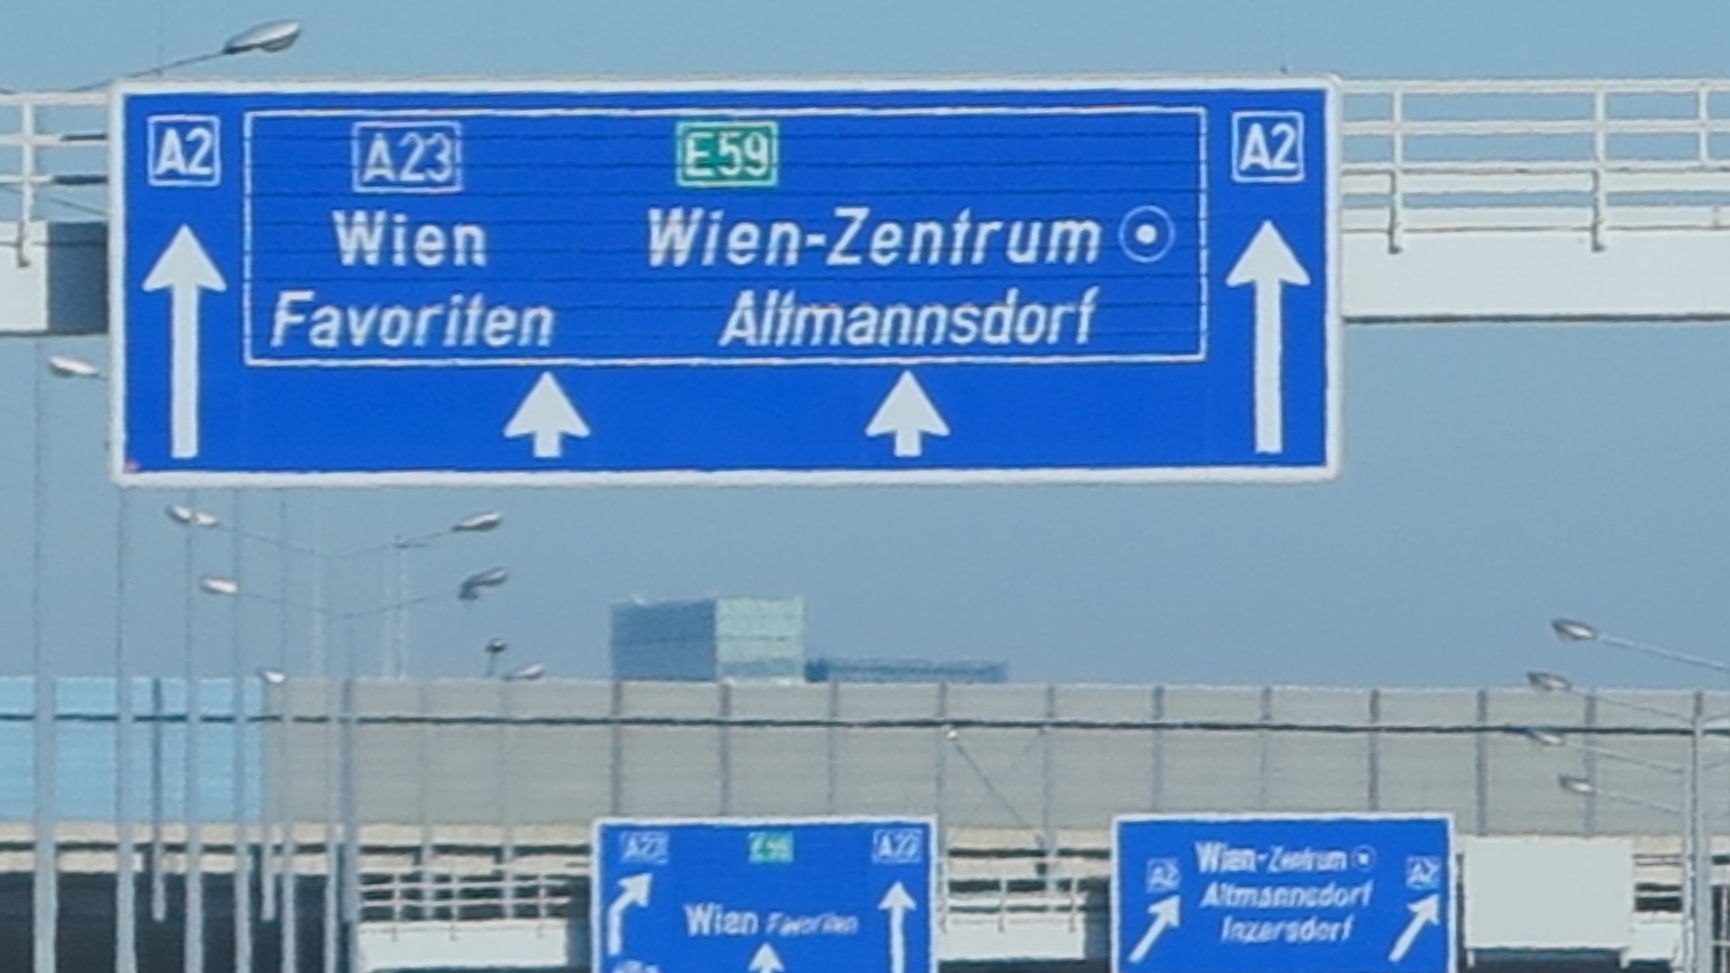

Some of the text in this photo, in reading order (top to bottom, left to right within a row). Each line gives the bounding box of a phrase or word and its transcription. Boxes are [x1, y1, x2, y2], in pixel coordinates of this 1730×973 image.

[155, 128, 214, 176] A2
[363, 135, 452, 181] A23
[684, 133, 769, 176] E59
[1240, 125, 1298, 171] A2
[332, 211, 487, 267] Wien
[648, 207, 1101, 266] Wien-Zentrum
[271, 291, 555, 347] Favoriten
[720, 288, 1100, 347] Altmannsdorf
[683, 902, 759, 937] Wien
